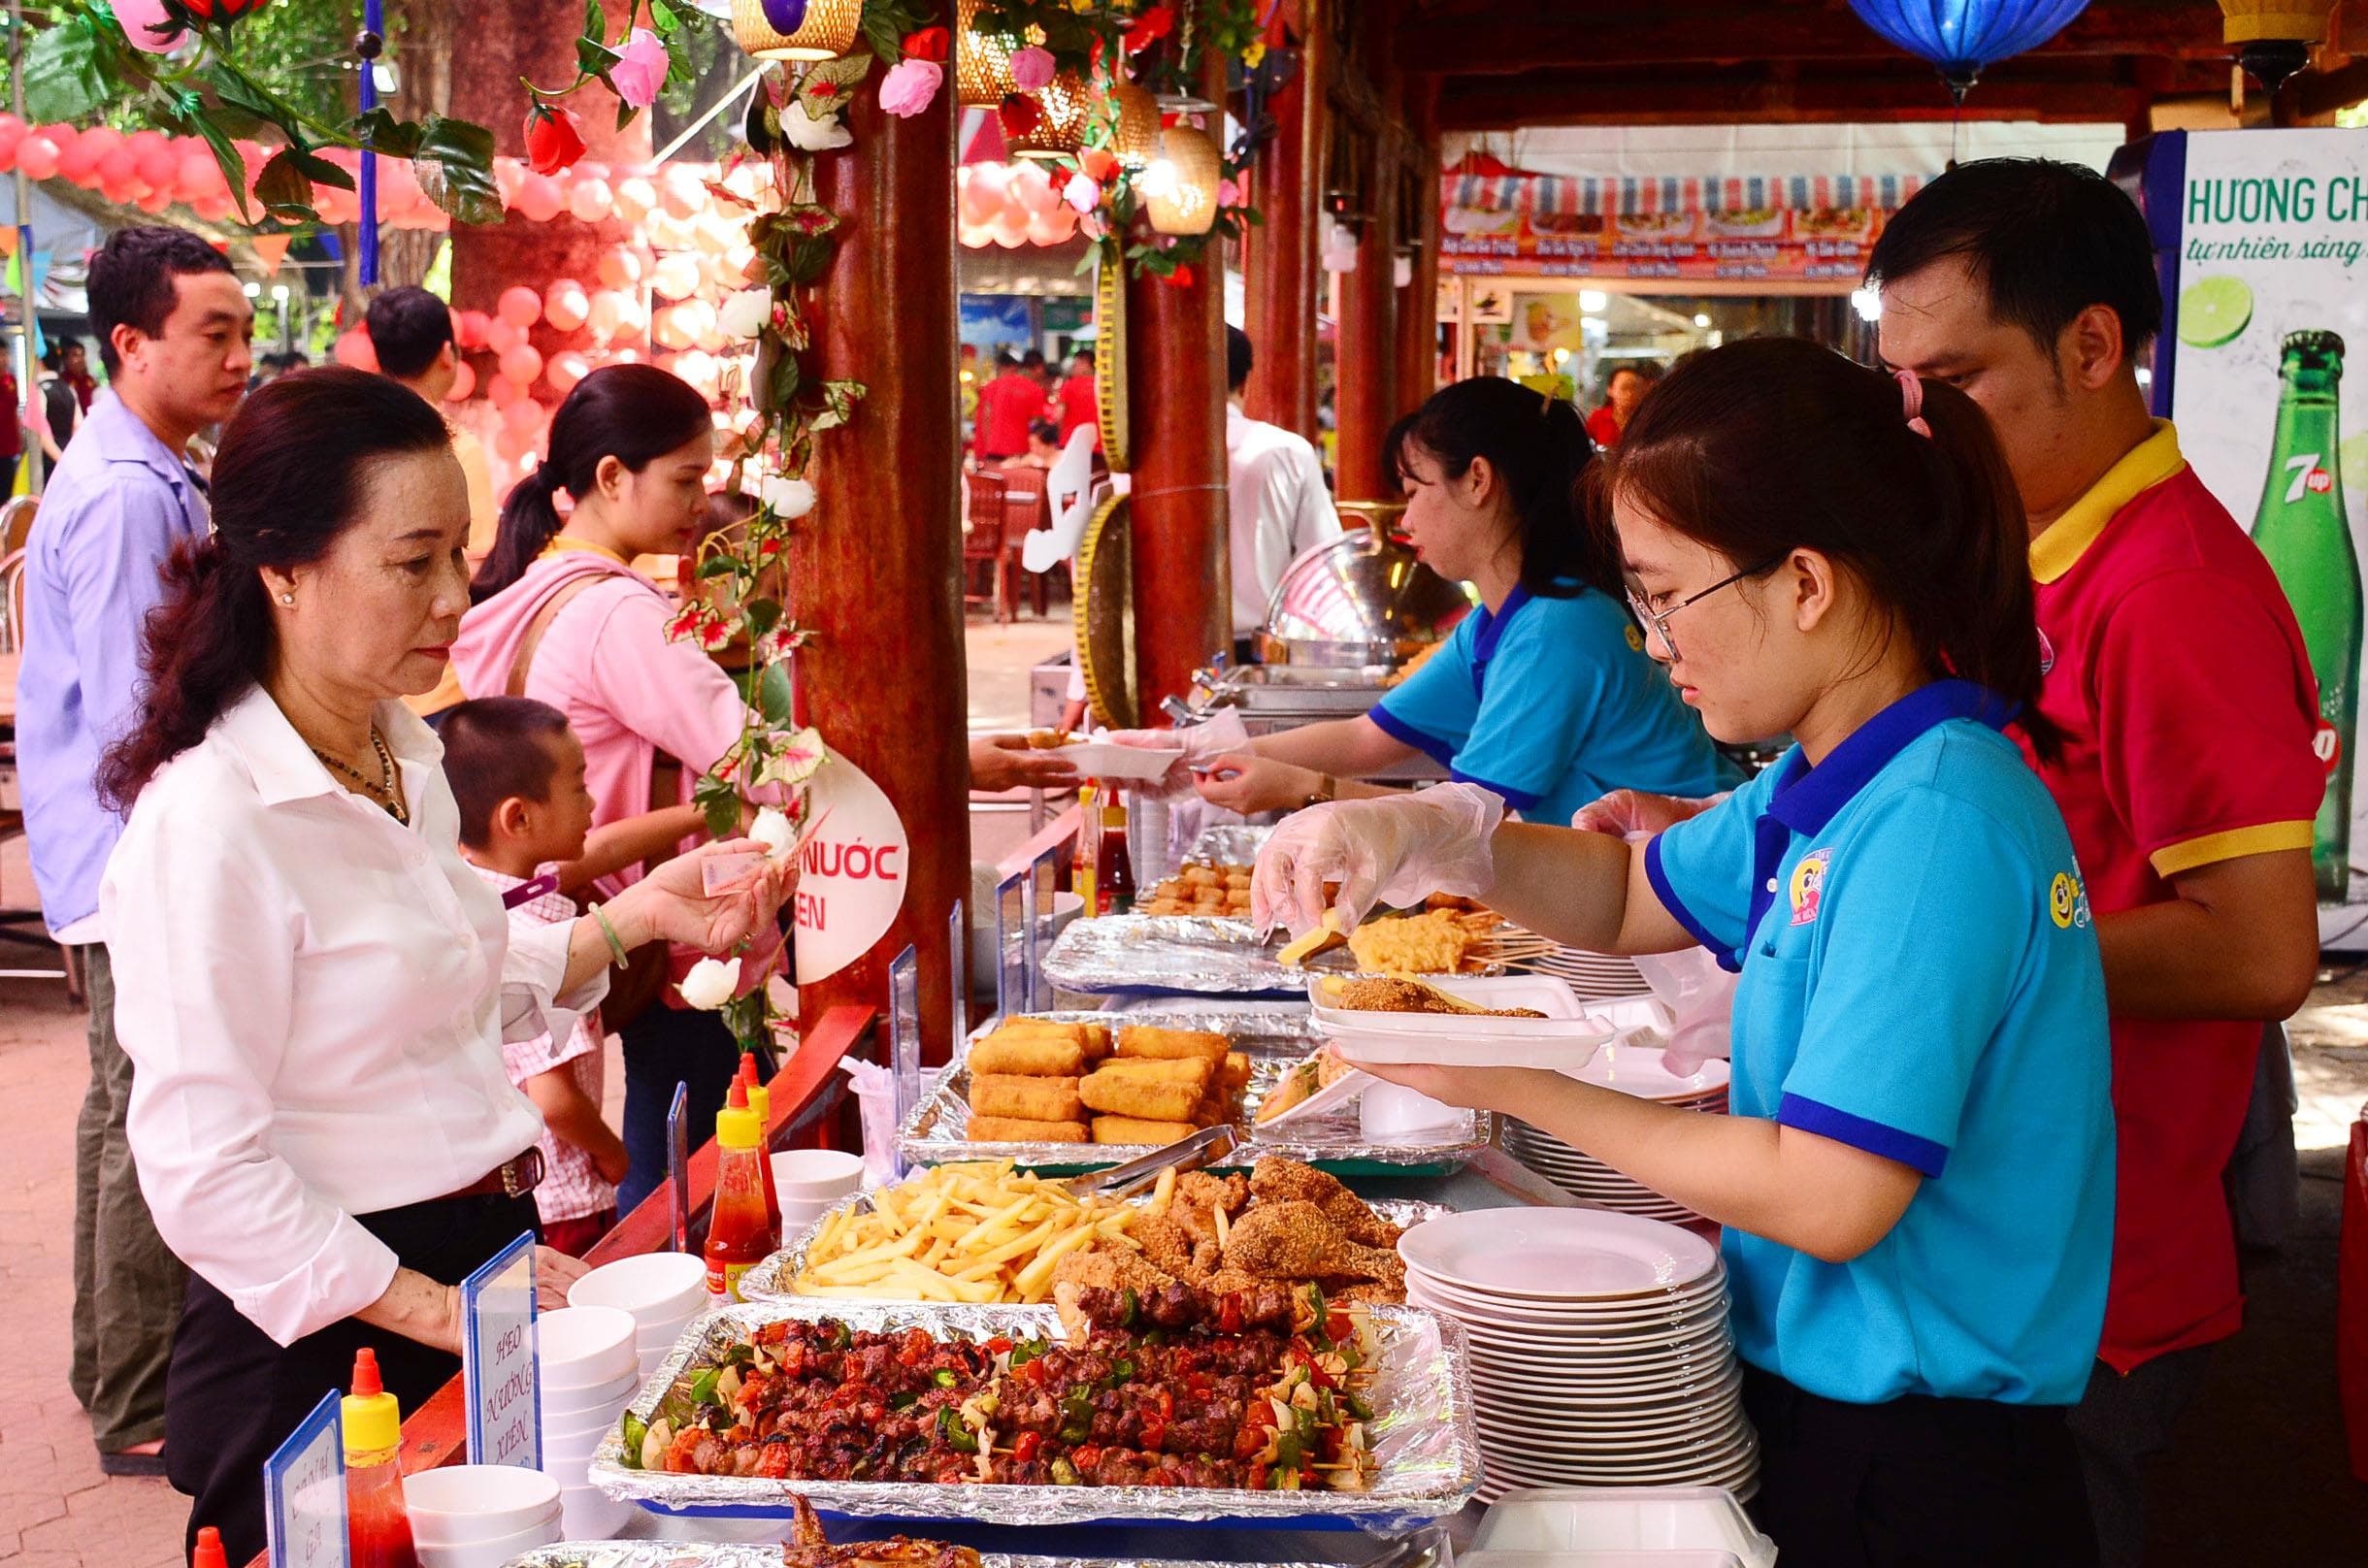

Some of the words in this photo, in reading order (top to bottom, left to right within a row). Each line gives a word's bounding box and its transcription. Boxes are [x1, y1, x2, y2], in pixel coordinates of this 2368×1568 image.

[2187, 177, 2316, 224] HƯƠNG
[2327, 176, 2368, 222] CH
[2217, 236, 2292, 260] nhiên
[803, 836, 900, 881] NƯỚC
[495, 1323, 521, 1366] HEO
